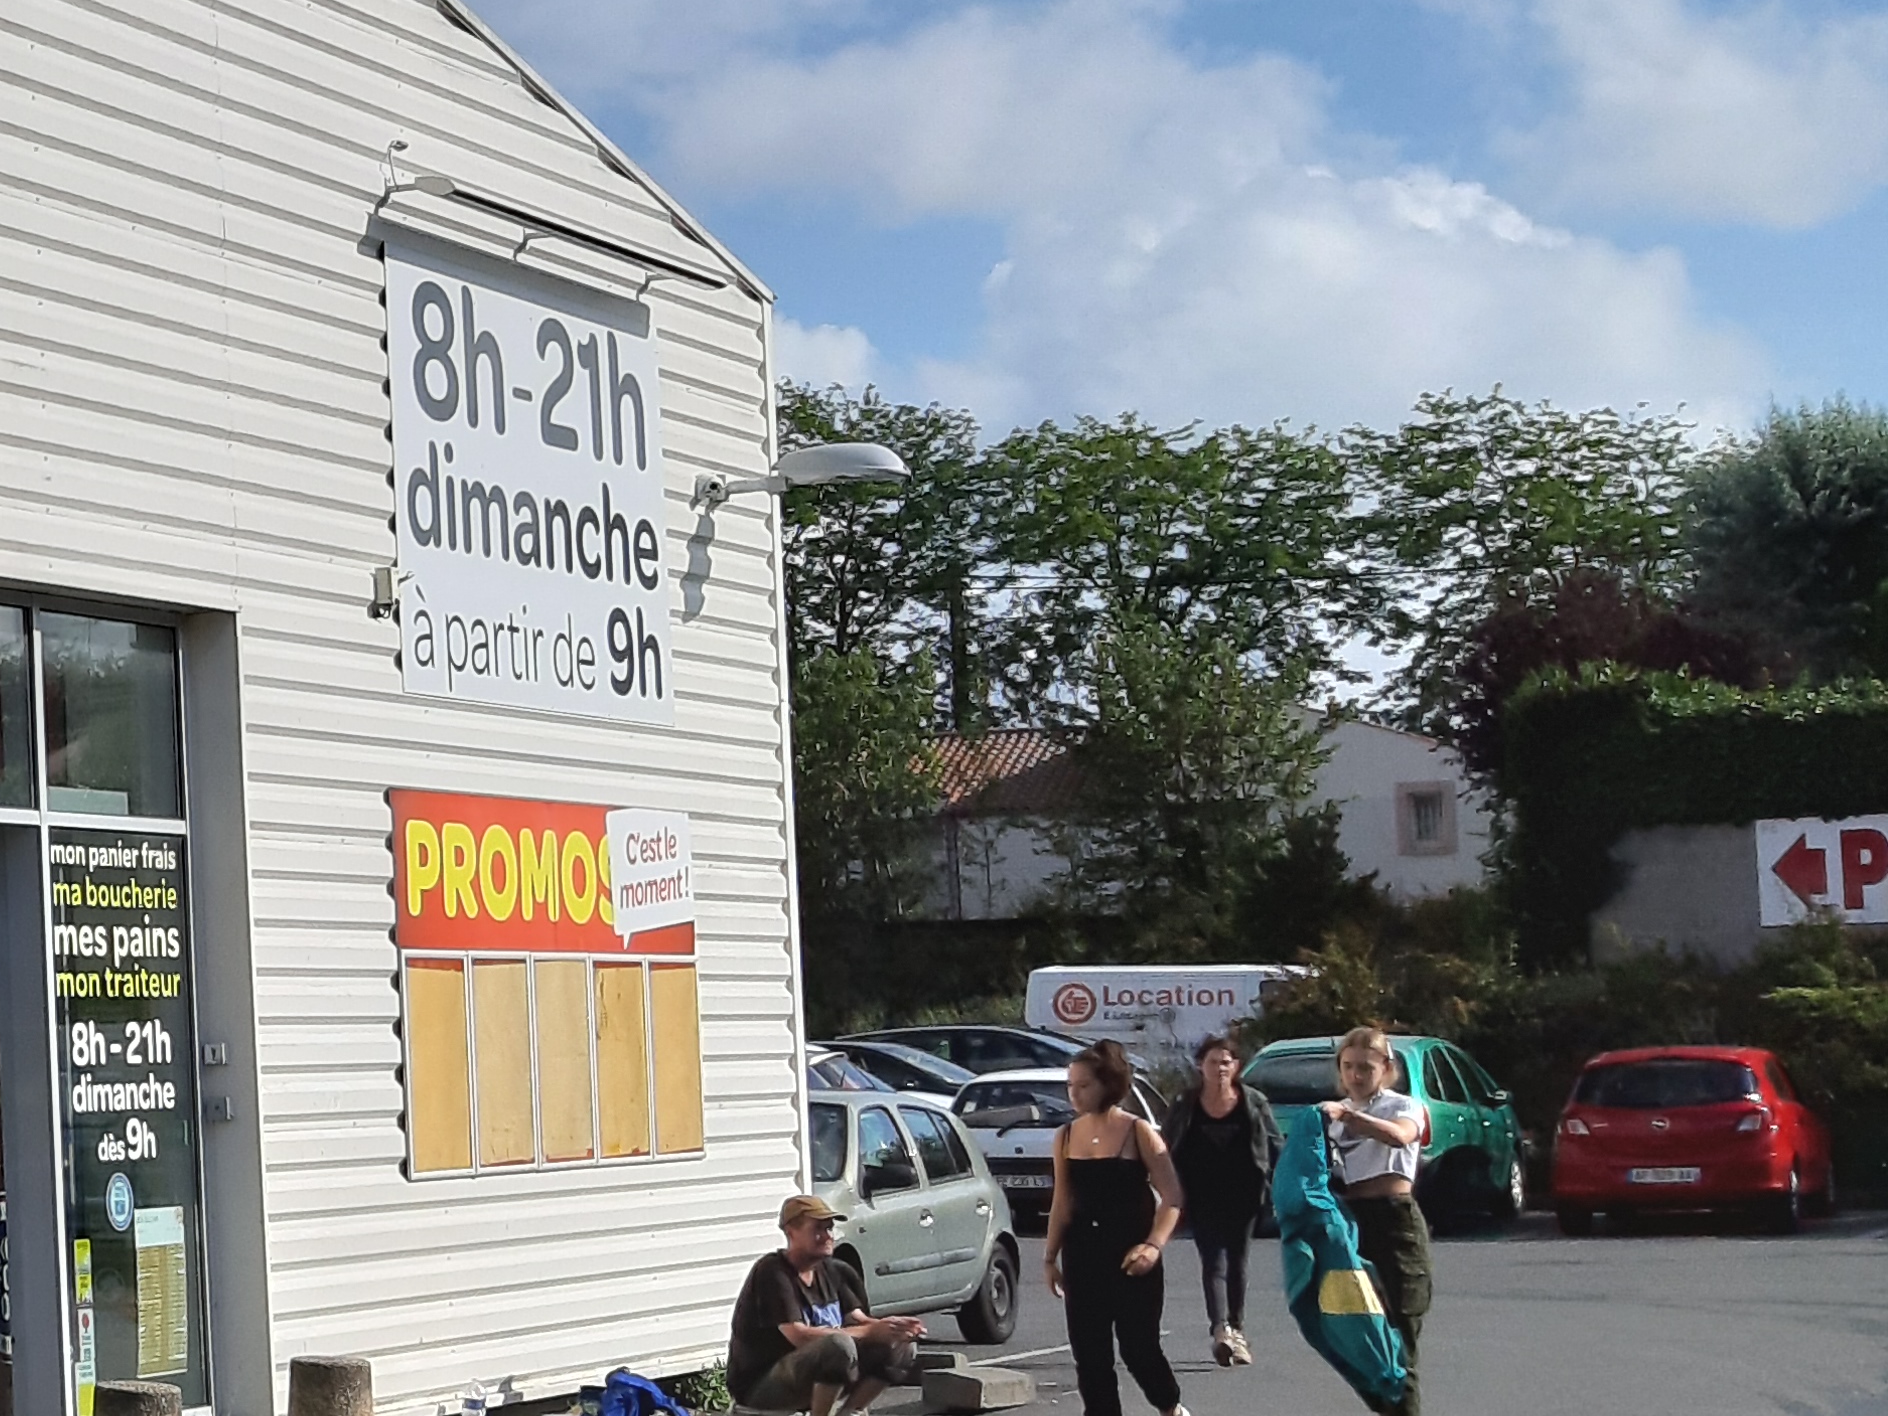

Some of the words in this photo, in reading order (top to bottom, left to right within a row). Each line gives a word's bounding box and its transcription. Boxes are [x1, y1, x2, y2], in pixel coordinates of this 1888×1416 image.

[407, 440, 659, 590] dimanche
[413, 585, 435, 668] à
[446, 605, 543, 692] partir
[553, 613, 596, 691] de
[608, 607, 662, 700] 9h
[50, 844, 86, 867] mon
[89, 840, 139, 873] panier
[141, 841, 177, 870] frais
[626, 830, 663, 865] C'est
[664, 826, 677, 860] le
[53, 881, 82, 907] ma
[85, 873, 178, 909] boucherie
[54, 924, 108, 957] mes
[112, 913, 180, 969] pains
[56, 972, 100, 998] mon
[104, 962, 181, 998] traiteur
[1103, 985, 1235, 1007] Location
[72, 1020, 107, 1066] 8h
[125, 1018, 172, 1065] 21h
[73, 1072, 175, 1113] dimanche
[98, 1133, 125, 1162] dès
[126, 1117, 157, 1160] 9h
